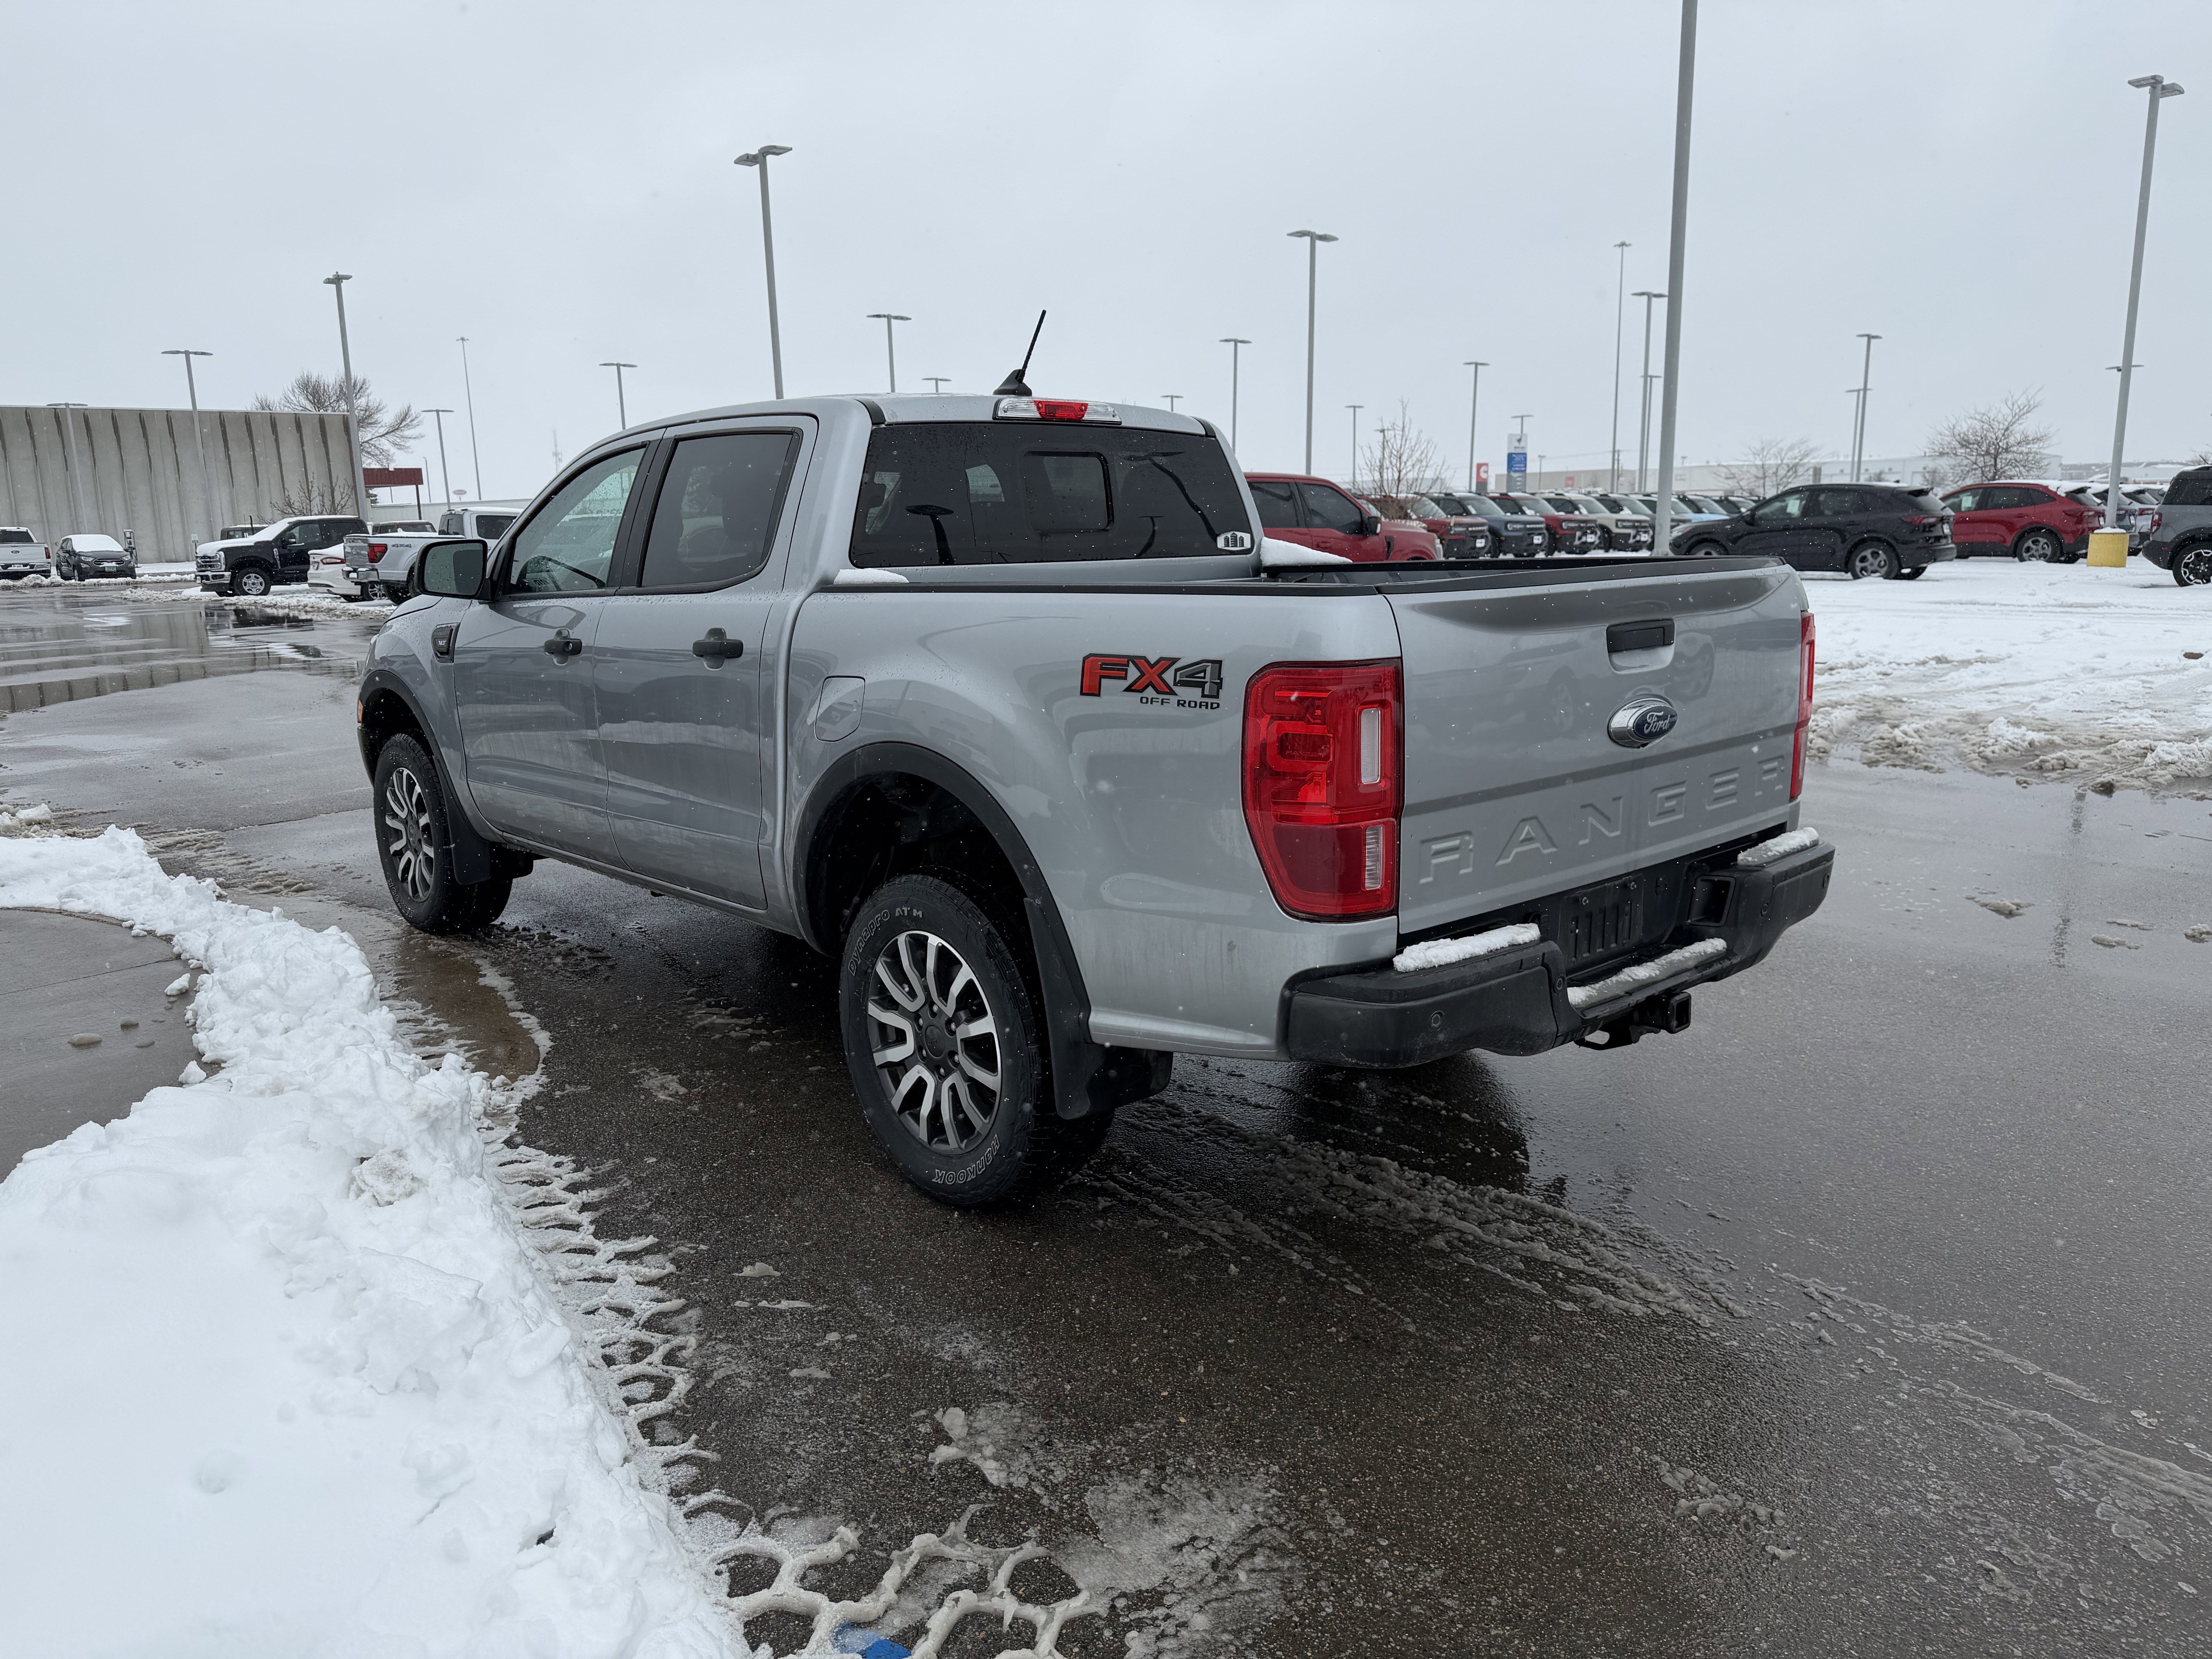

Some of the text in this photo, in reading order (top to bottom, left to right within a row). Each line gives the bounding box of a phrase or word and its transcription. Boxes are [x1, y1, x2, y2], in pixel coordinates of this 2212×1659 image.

[1080, 653, 1223, 699] FX4
[1140, 696, 1220, 710] OFF ROAD
[1644, 711, 1671, 734] Ford
[1419, 754, 1784, 884] RANGER
[848, 910, 890, 977] Dynapro
